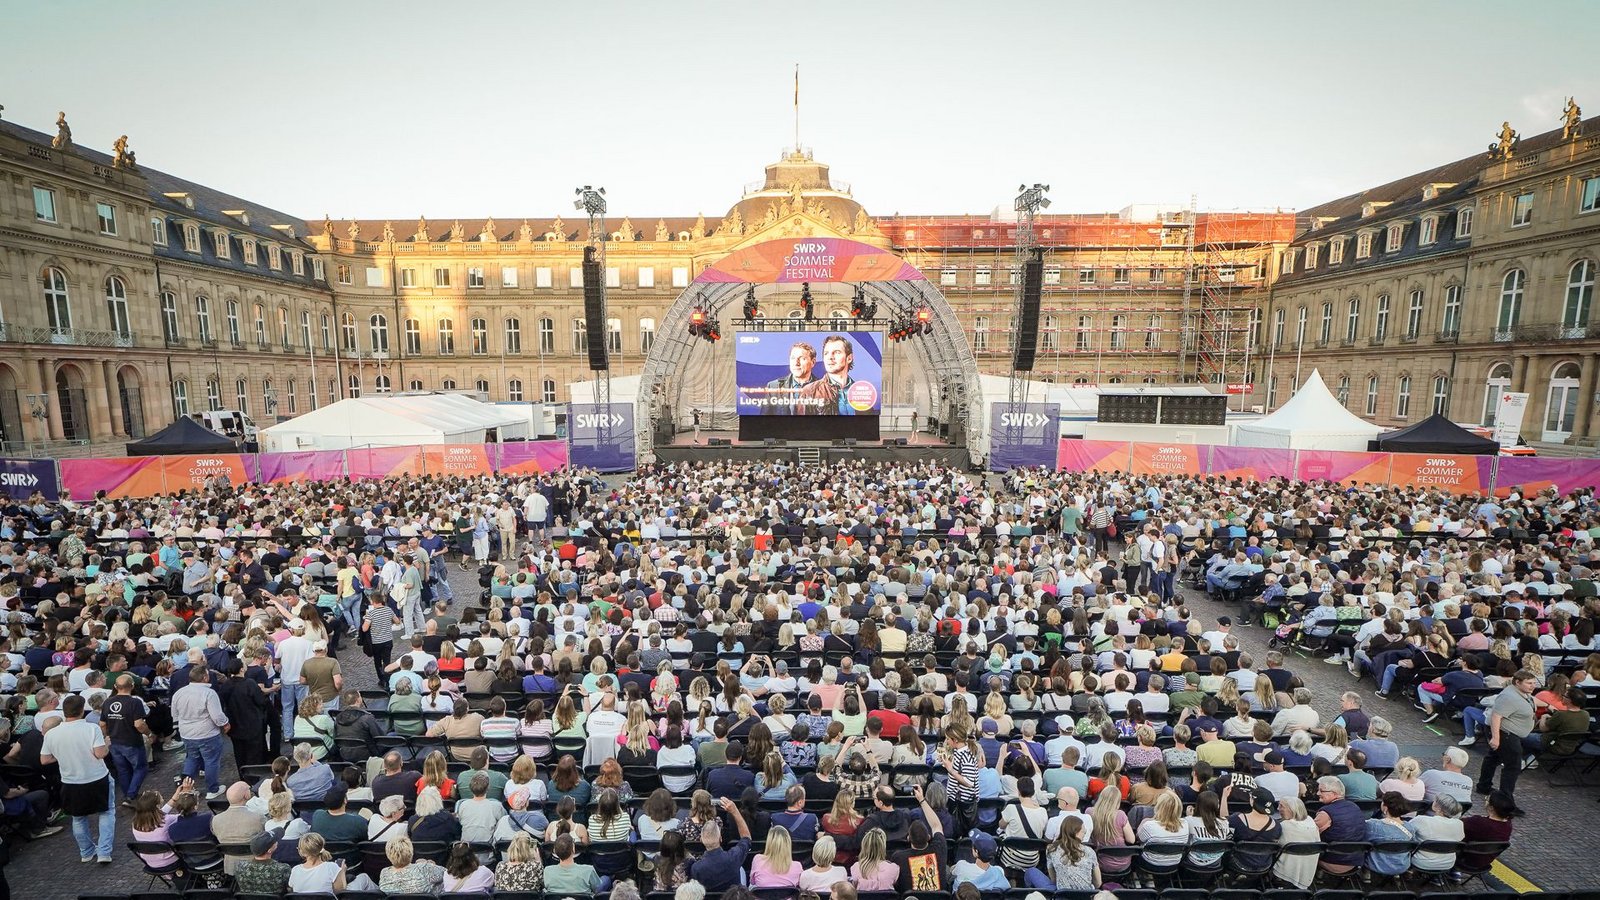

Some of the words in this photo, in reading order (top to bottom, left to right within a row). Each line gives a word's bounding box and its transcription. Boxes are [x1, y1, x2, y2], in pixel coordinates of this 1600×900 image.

[794, 243, 816, 253] SWR
[784, 256, 835, 266] SOMMER
[786, 268, 833, 279] FESTIVAL
[740, 397, 768, 407] Lucys
[770, 396, 825, 406] Geburtstag
[576, 413, 609, 428] SWR
[1000, 412, 1034, 427] SWR
[1151, 454, 1188, 463] SOMMER
[445, 462, 477, 470] FESTIVAL
[1151, 462, 1186, 470] FESTIVAL
[189, 467, 232, 476] SOMMER
[1416, 467, 1463, 476] SOMMER
[0, 472, 27, 487] SWR
[1417, 476, 1460, 485] FESTIVAL
